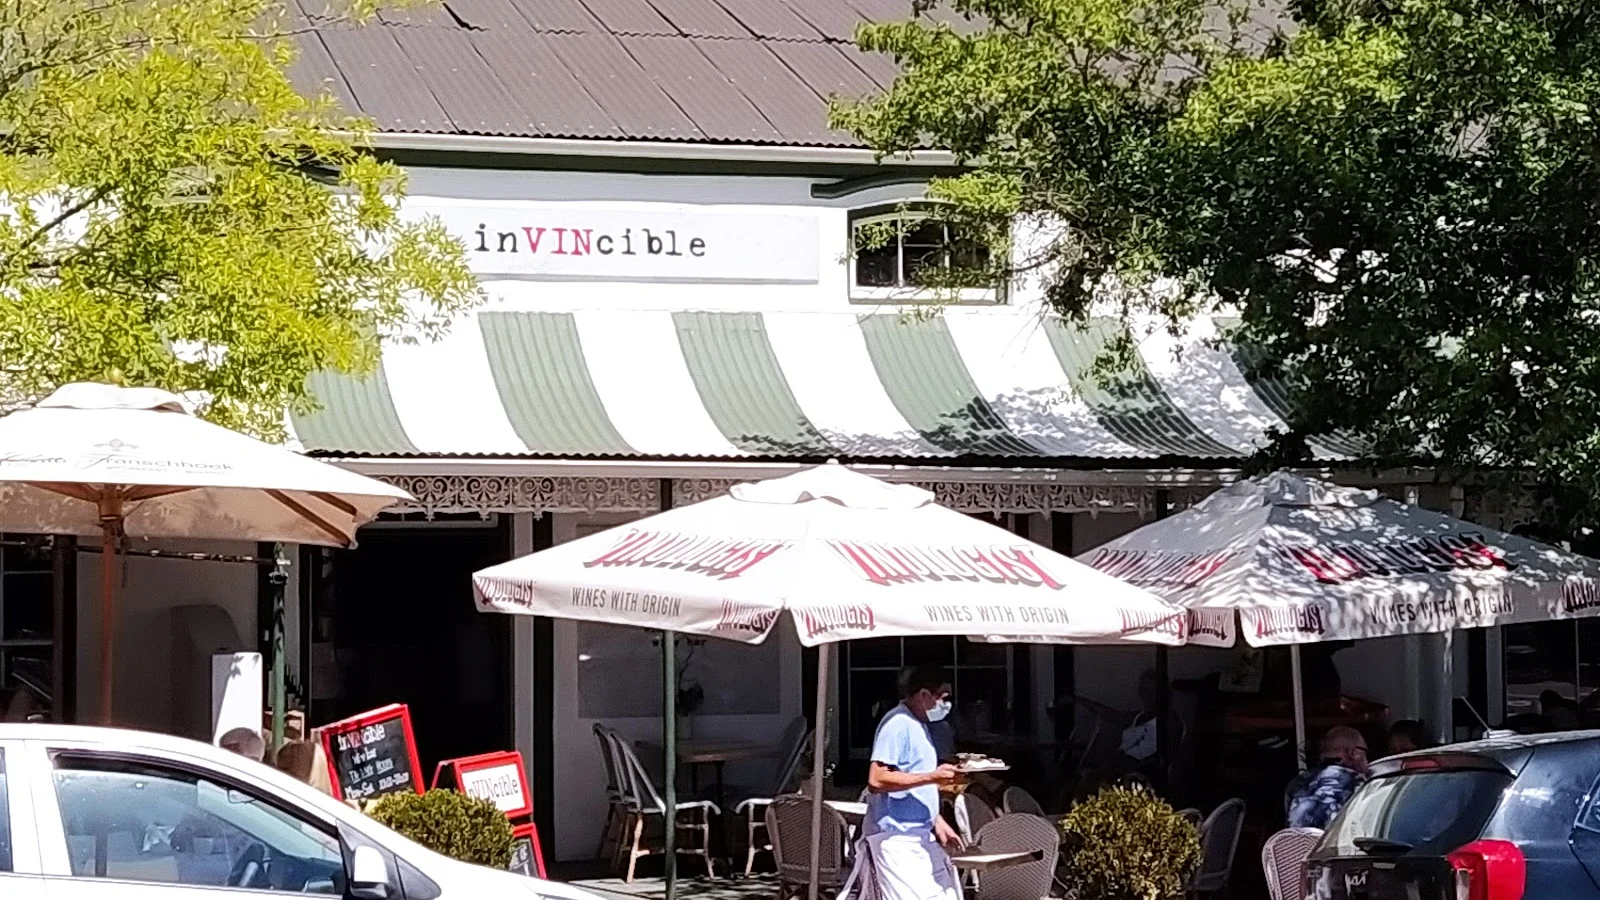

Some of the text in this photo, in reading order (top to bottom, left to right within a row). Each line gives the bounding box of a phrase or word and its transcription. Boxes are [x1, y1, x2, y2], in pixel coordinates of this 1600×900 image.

[475, 223, 706, 257] inVINcible
[818, 538, 1067, 590] VINOLOGIST
[572, 586, 682, 617] WINES WITH ORIGIN
[923, 605, 1070, 624] WINES WITH ORIGIN
[1370, 590, 1514, 625] WINES WITH ORIGIN
[792, 603, 876, 638] VINOLOGIST
[1250, 603, 1325, 638] VINOLOGIST
[468, 774, 519, 799] nVINcible
